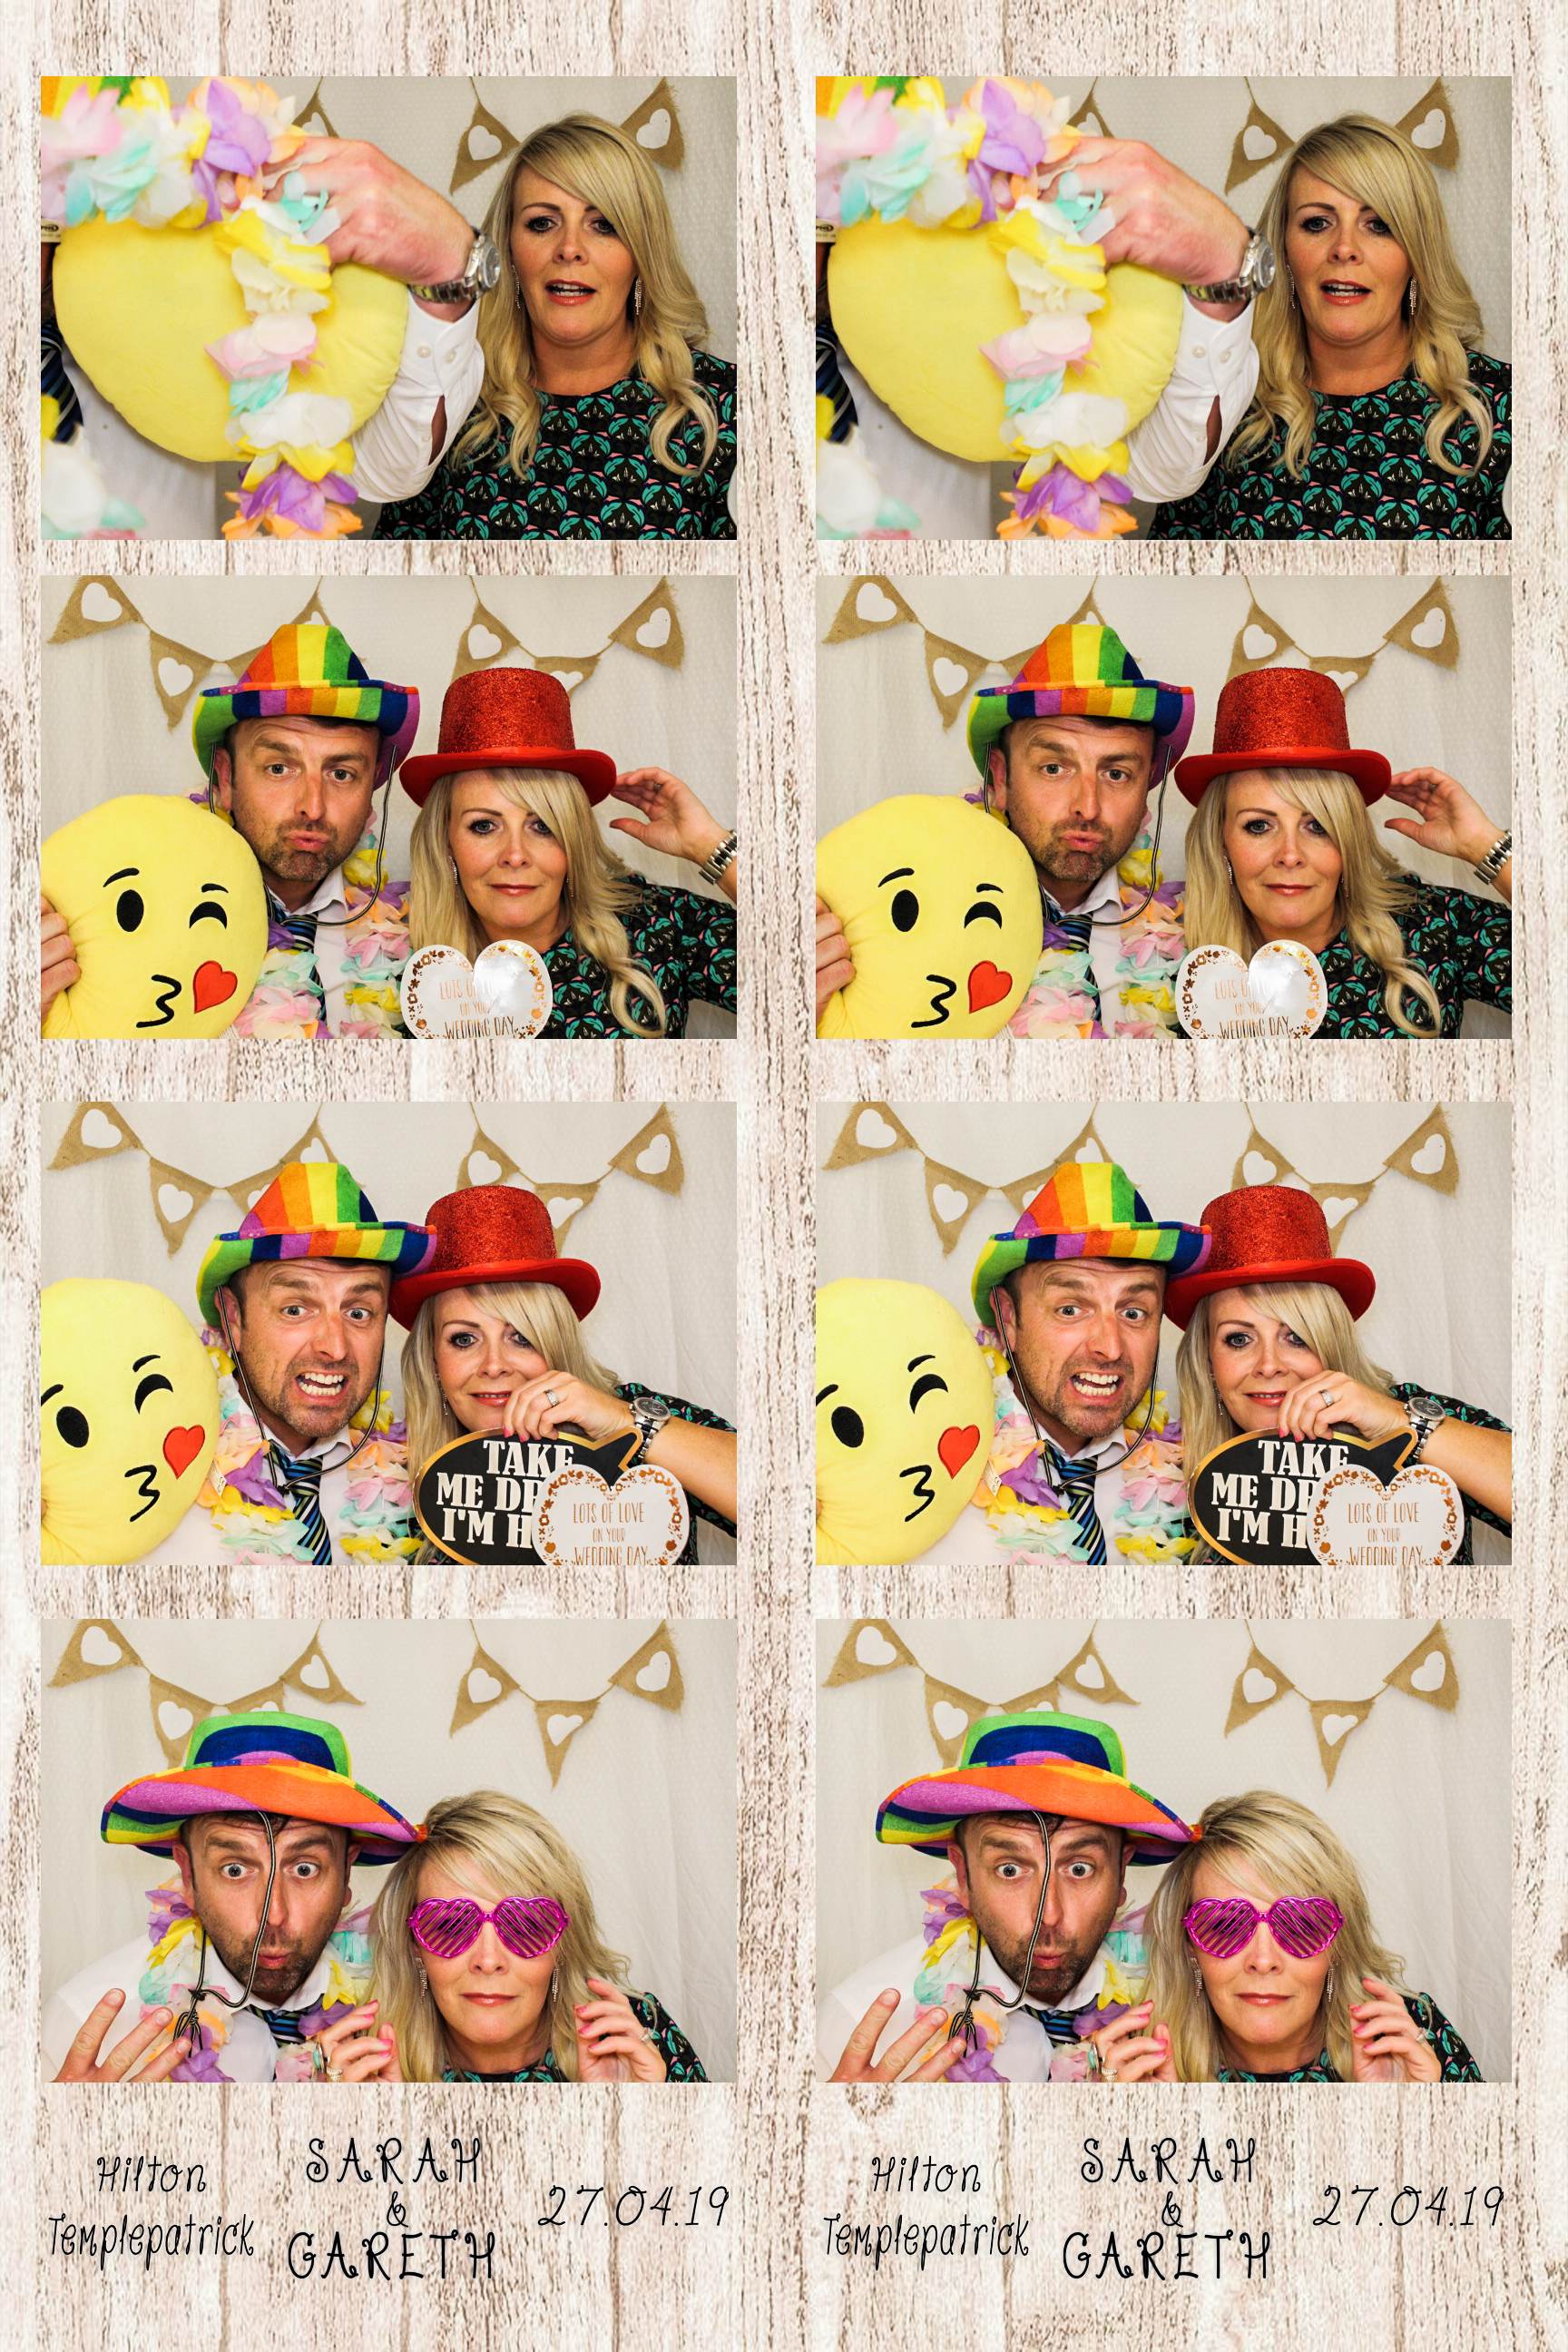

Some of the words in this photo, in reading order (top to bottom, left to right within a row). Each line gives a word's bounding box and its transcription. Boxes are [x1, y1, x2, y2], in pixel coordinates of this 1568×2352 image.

[439, 979, 463, 1000] LOTS
[1214, 979, 1238, 1000] LOTS
[459, 1002, 471, 1016] ON
[1234, 1002, 1246, 1016] ON
[444, 1018, 491, 1039] WEDDING
[494, 1015, 514, 1036] DAY
[1219, 1018, 1266, 1039] WEDDING
[1269, 1015, 1289, 1036] DAY
[483, 1439, 574, 1478] TAKE
[1258, 1439, 1349, 1478] TAKE
[436, 1472, 485, 1509] ME
[494, 1476, 544, 1514] DR
[1210, 1472, 1259, 1509] ME
[1269, 1476, 1319, 1514] DR
[573, 1502, 597, 1524] LOTS
[601, 1502, 614, 1524] OF
[618, 1502, 645, 1524] LOVE
[1348, 1502, 1372, 1524] LOTS
[1376, 1502, 1389, 1524] OF
[1393, 1502, 1420, 1524] LOVE
[442, 1507, 496, 1545] I'M
[505, 1513, 533, 1549] H
[593, 1527, 603, 1543] ON
[605, 1527, 626, 1543] YOUR
[1217, 1507, 1271, 1545] I'M
[1280, 1513, 1308, 1549] H
[1367, 1527, 1378, 1543] ON
[1380, 1527, 1401, 1543] YOUR
[574, 1545, 623, 1565] WEDDING
[626, 1545, 649, 1565] DAY
[1349, 1545, 1398, 1565] WEDDING
[1401, 1545, 1424, 1565] DAY
